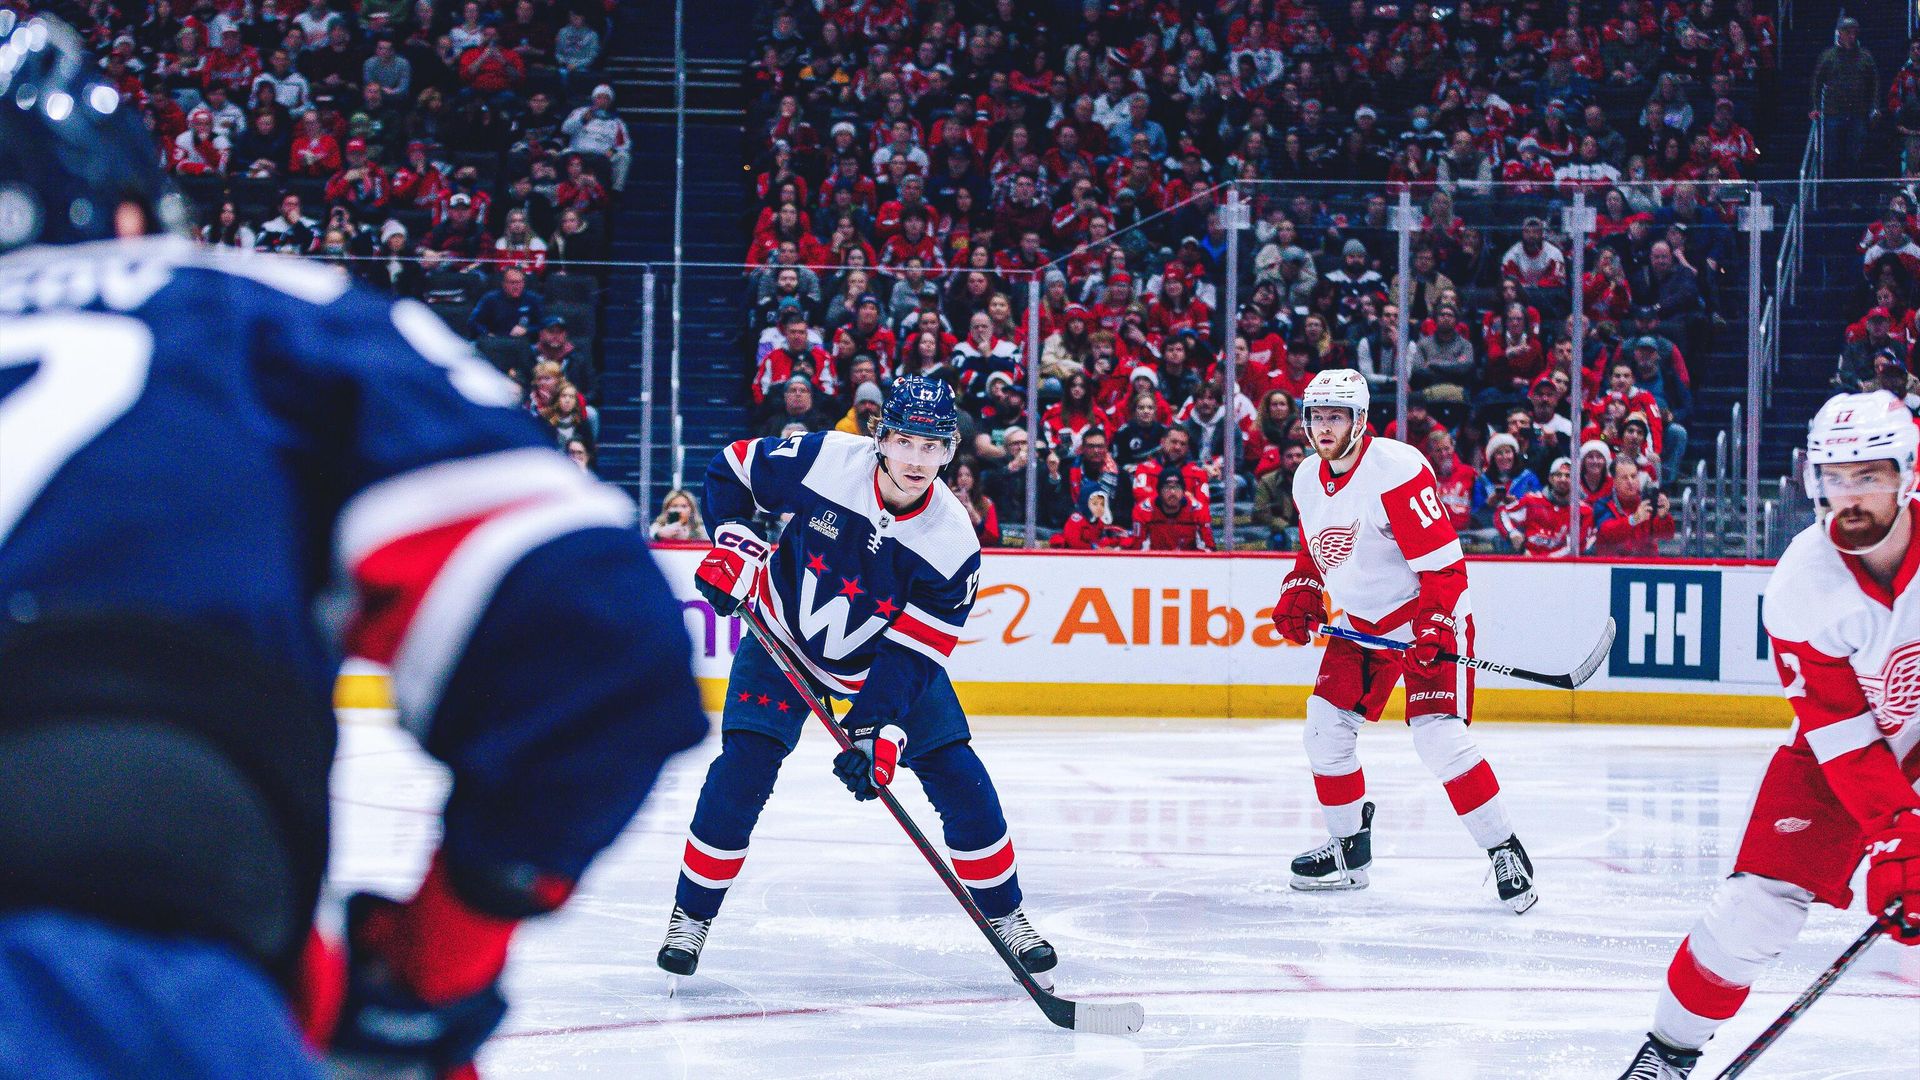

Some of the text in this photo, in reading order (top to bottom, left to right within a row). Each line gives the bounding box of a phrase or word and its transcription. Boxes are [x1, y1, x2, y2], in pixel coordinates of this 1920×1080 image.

[1836, 409, 1854, 424] 17
[1825, 437, 1858, 445] CCM
[1409, 486, 1442, 529] 18
[811, 516, 839, 536] CAESARS
[1456, 656, 1515, 676] BAUER
[1409, 691, 1455, 703] BAUER
